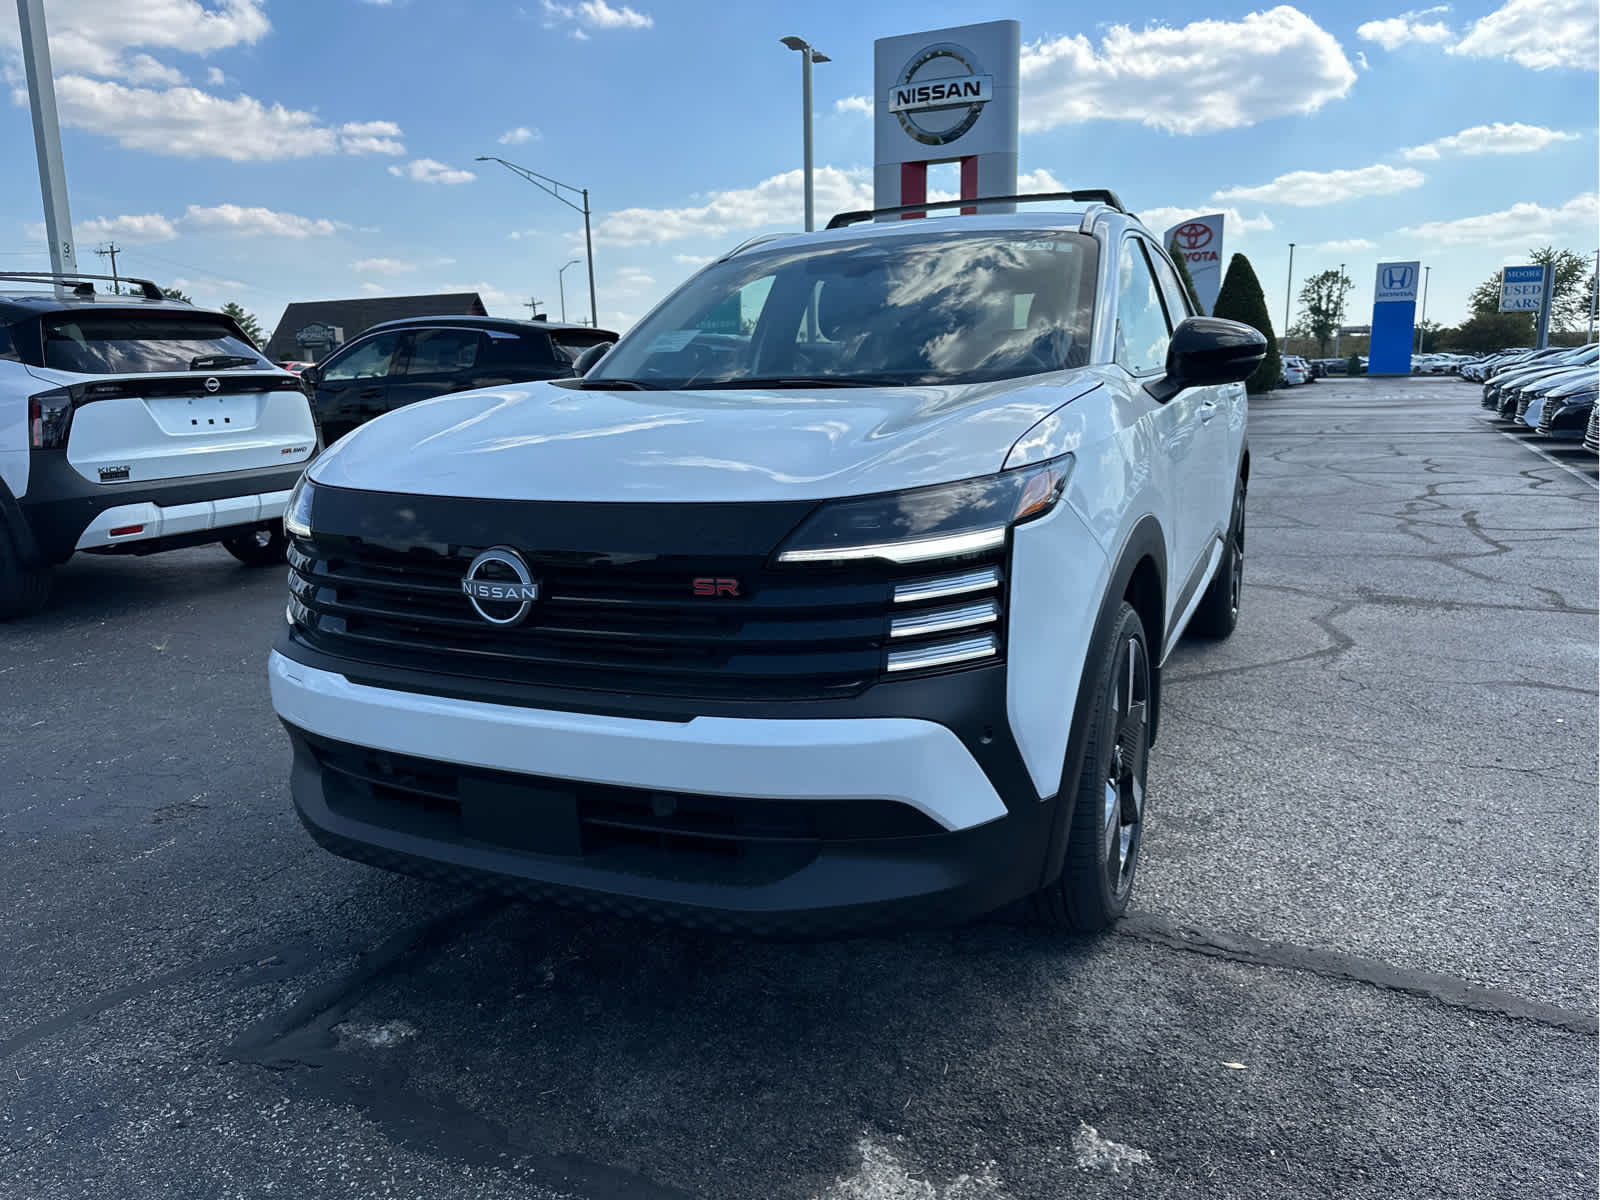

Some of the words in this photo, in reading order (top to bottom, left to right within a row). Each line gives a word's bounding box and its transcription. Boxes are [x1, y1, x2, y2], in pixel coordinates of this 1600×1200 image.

[897, 81, 980, 106] NISSAN
[63, 242, 70, 254] 3
[1184, 251, 1218, 262] YOTA
[1507, 270, 1542, 278] MOORE
[1504, 285, 1542, 297] USED
[1502, 299, 1540, 309] CARS
[97, 464, 131, 473] KICKS
[463, 582, 536, 599] NISSAN
[693, 578, 739, 596] SR
